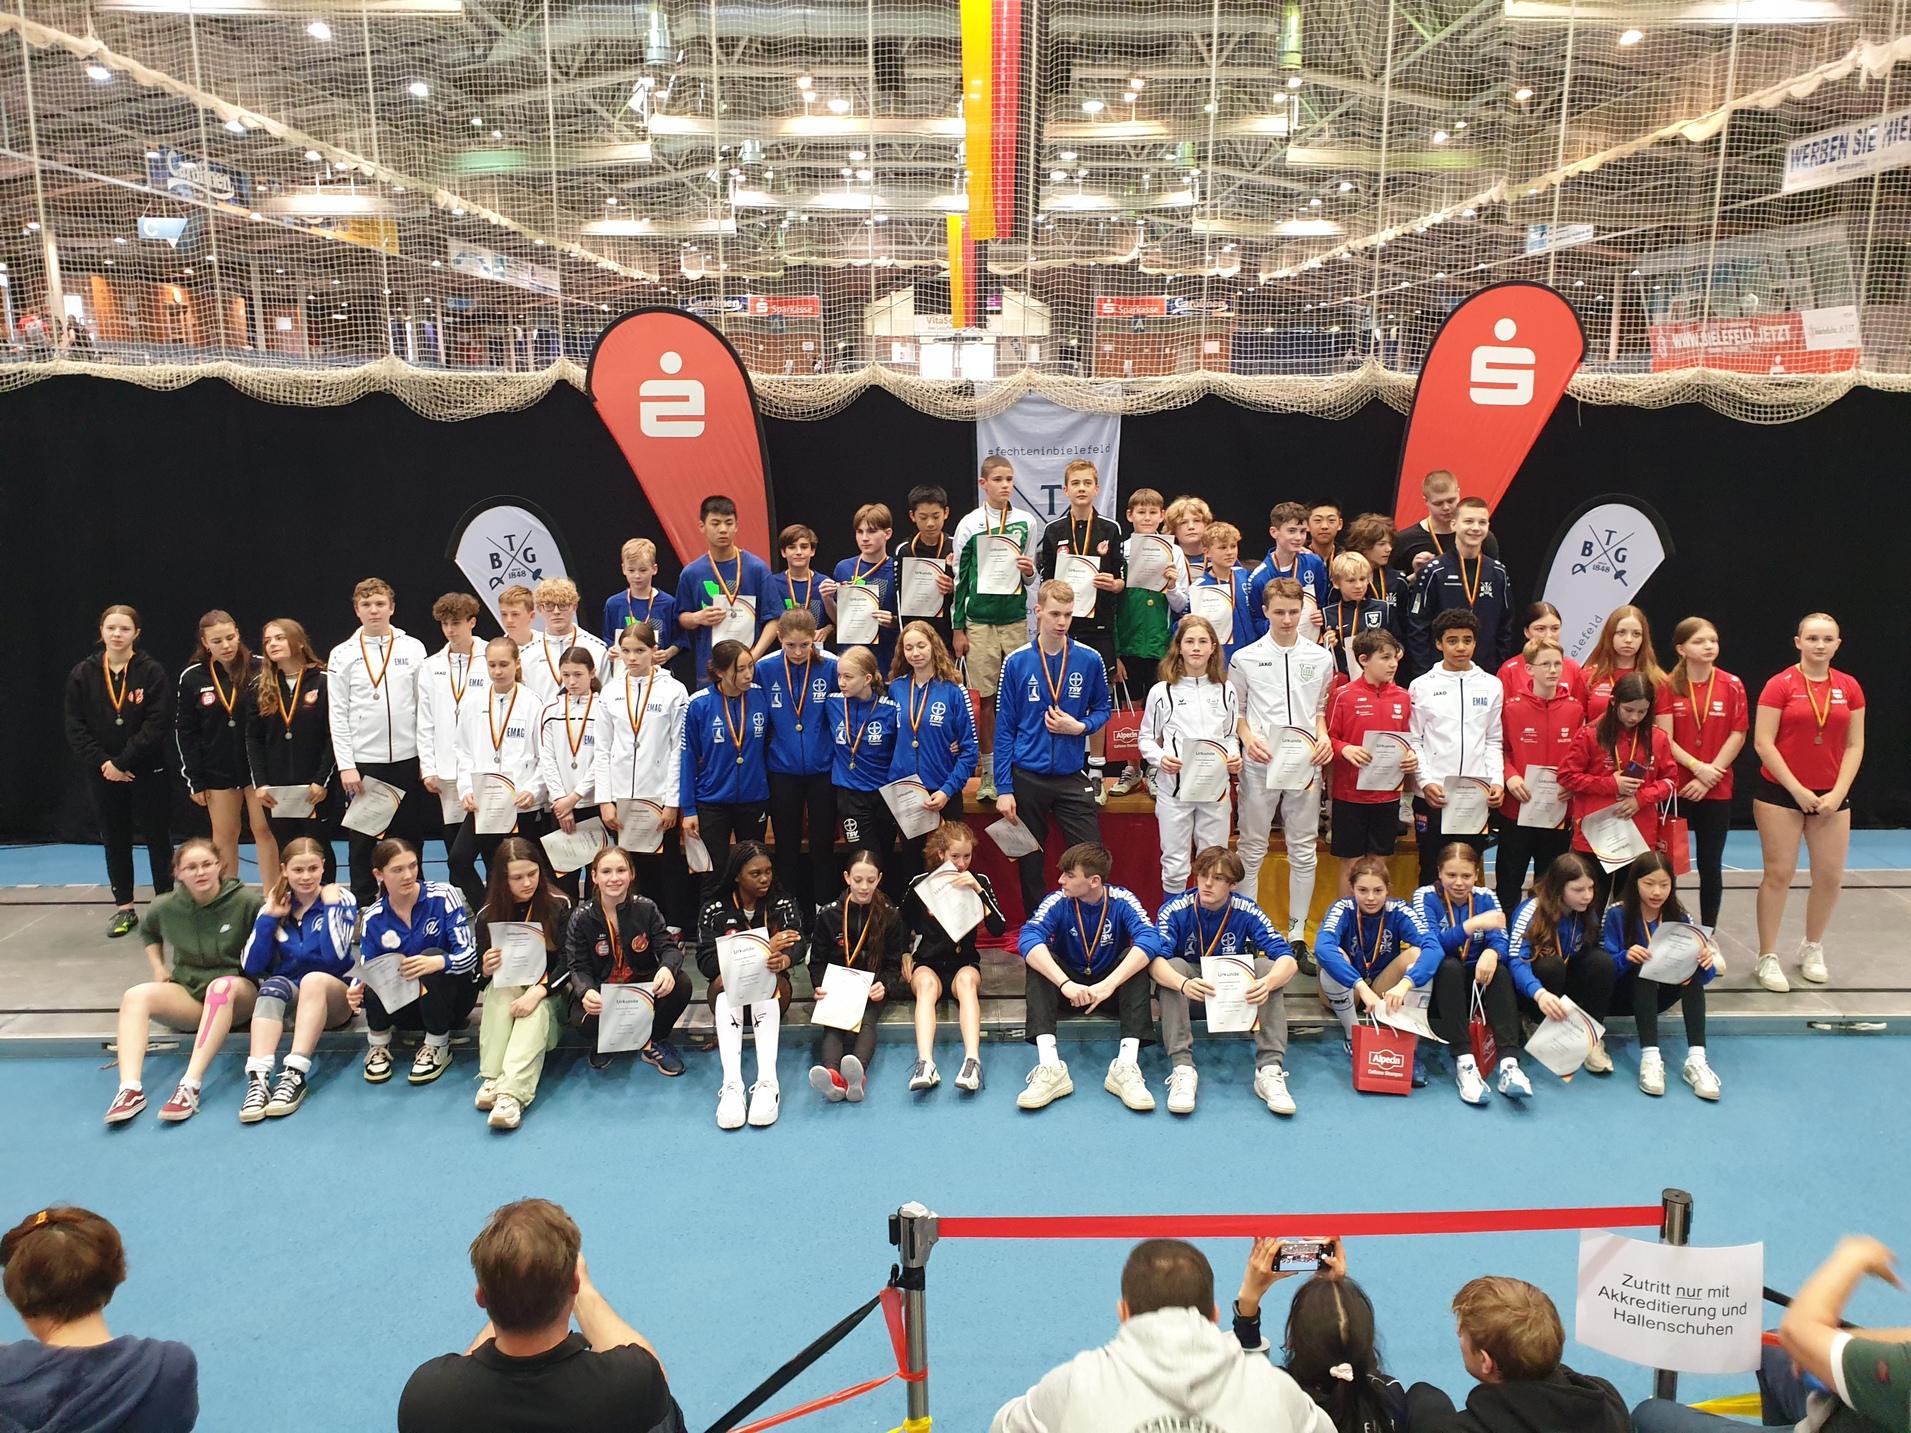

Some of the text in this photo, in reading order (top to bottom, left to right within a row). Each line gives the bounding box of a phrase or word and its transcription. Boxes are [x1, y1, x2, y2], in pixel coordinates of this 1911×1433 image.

[1790, 131, 1849, 172] WERBEN
[1852, 124, 1878, 156] SIE
[771, 304, 814, 315] Sparkasse
[1118, 304, 1160, 315] Sparkasse
[987, 444, 1112, 457] #fechteninbielefeld
[394, 657, 409, 666] EMAG
[469, 678, 484, 687] EMAG
[813, 691, 827, 699] TSV
[1068, 686, 1083, 694] TSV
[1472, 696, 1488, 706] EMAG
[647, 702, 662, 713] EMAG
[929, 714, 945, 723] TSV
[506, 726, 526, 739] EMAG
[867, 734, 882, 742] TSV
[1221, 945, 1237, 953] TSV
[1372, 1054, 1401, 1066] Alpecin
[1621, 1273, 1730, 1299] Zutritt nur mit
[1598, 1285, 1748, 1320] Akkreditierung und
[1613, 1307, 1733, 1336] Hallenschuhen
